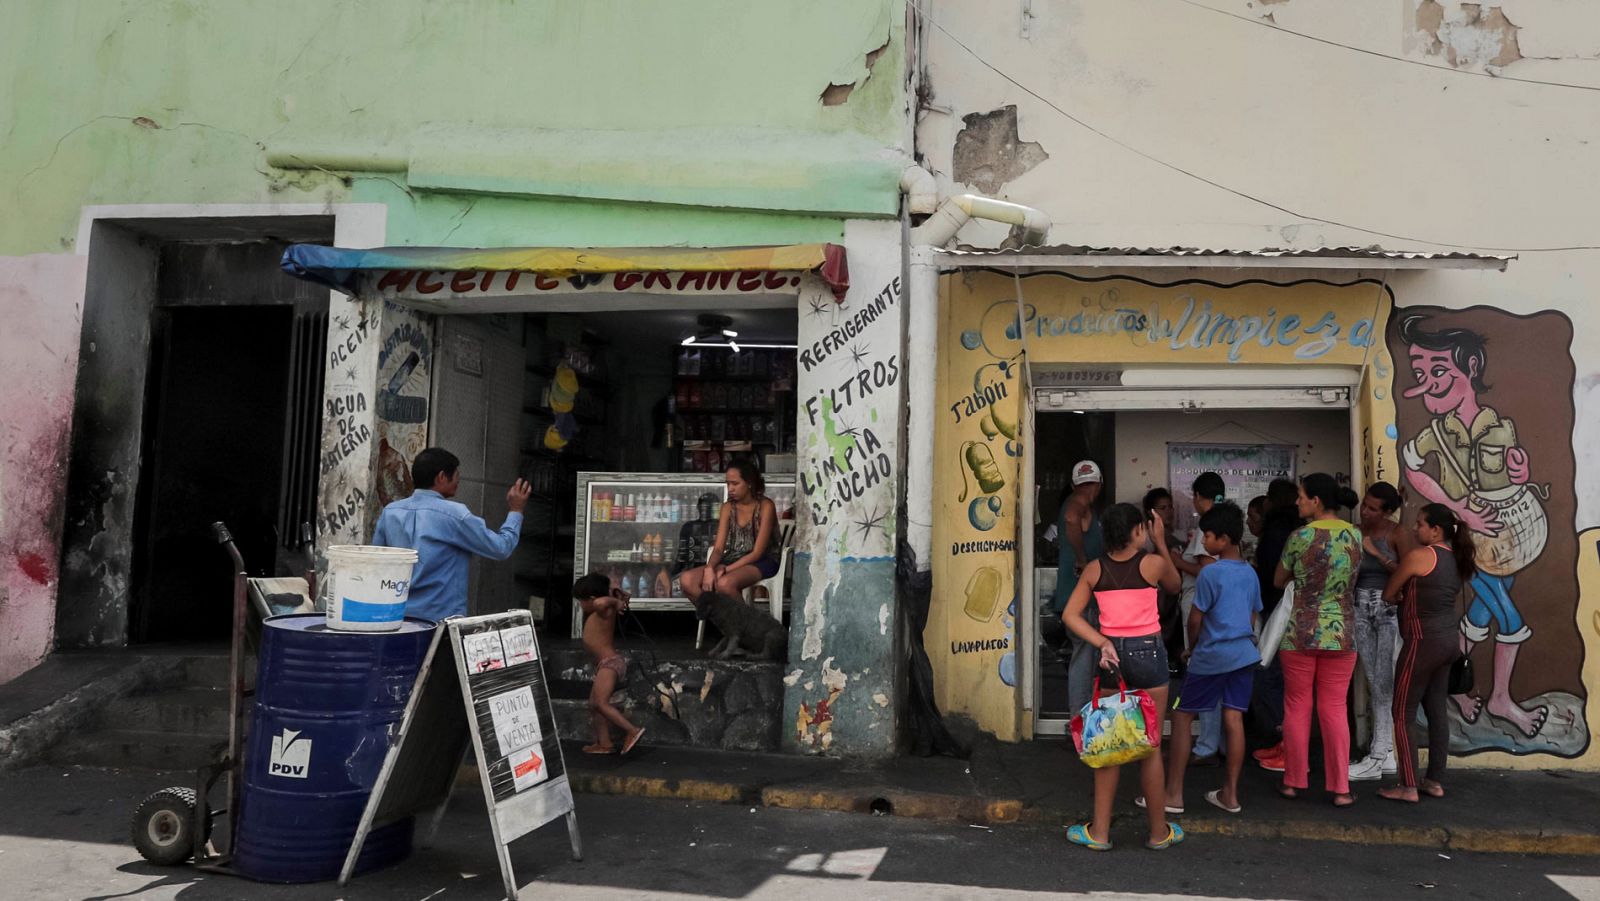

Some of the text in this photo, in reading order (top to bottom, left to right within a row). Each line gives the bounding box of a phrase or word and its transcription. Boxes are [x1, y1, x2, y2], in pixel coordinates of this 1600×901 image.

[800, 276, 900, 372] REFRIGERANTE
[330, 310, 379, 370] ACEITE
[805, 354, 898, 426] FLTROS
[326, 392, 366, 418] AGUA
[321, 424, 371, 475] BATERIA
[1232, 468, 1244, 477] DE
[1246, 468, 1289, 478] LIMPIEZA
[1500, 501, 1530, 519] MAIZ
[951, 638, 1009, 655] LAVAPLATOS
[496, 694, 529, 716] PUNTO
[512, 714, 520, 725] DE
[503, 722, 536, 749] VENTA
[271, 763, 304, 775] PDV
